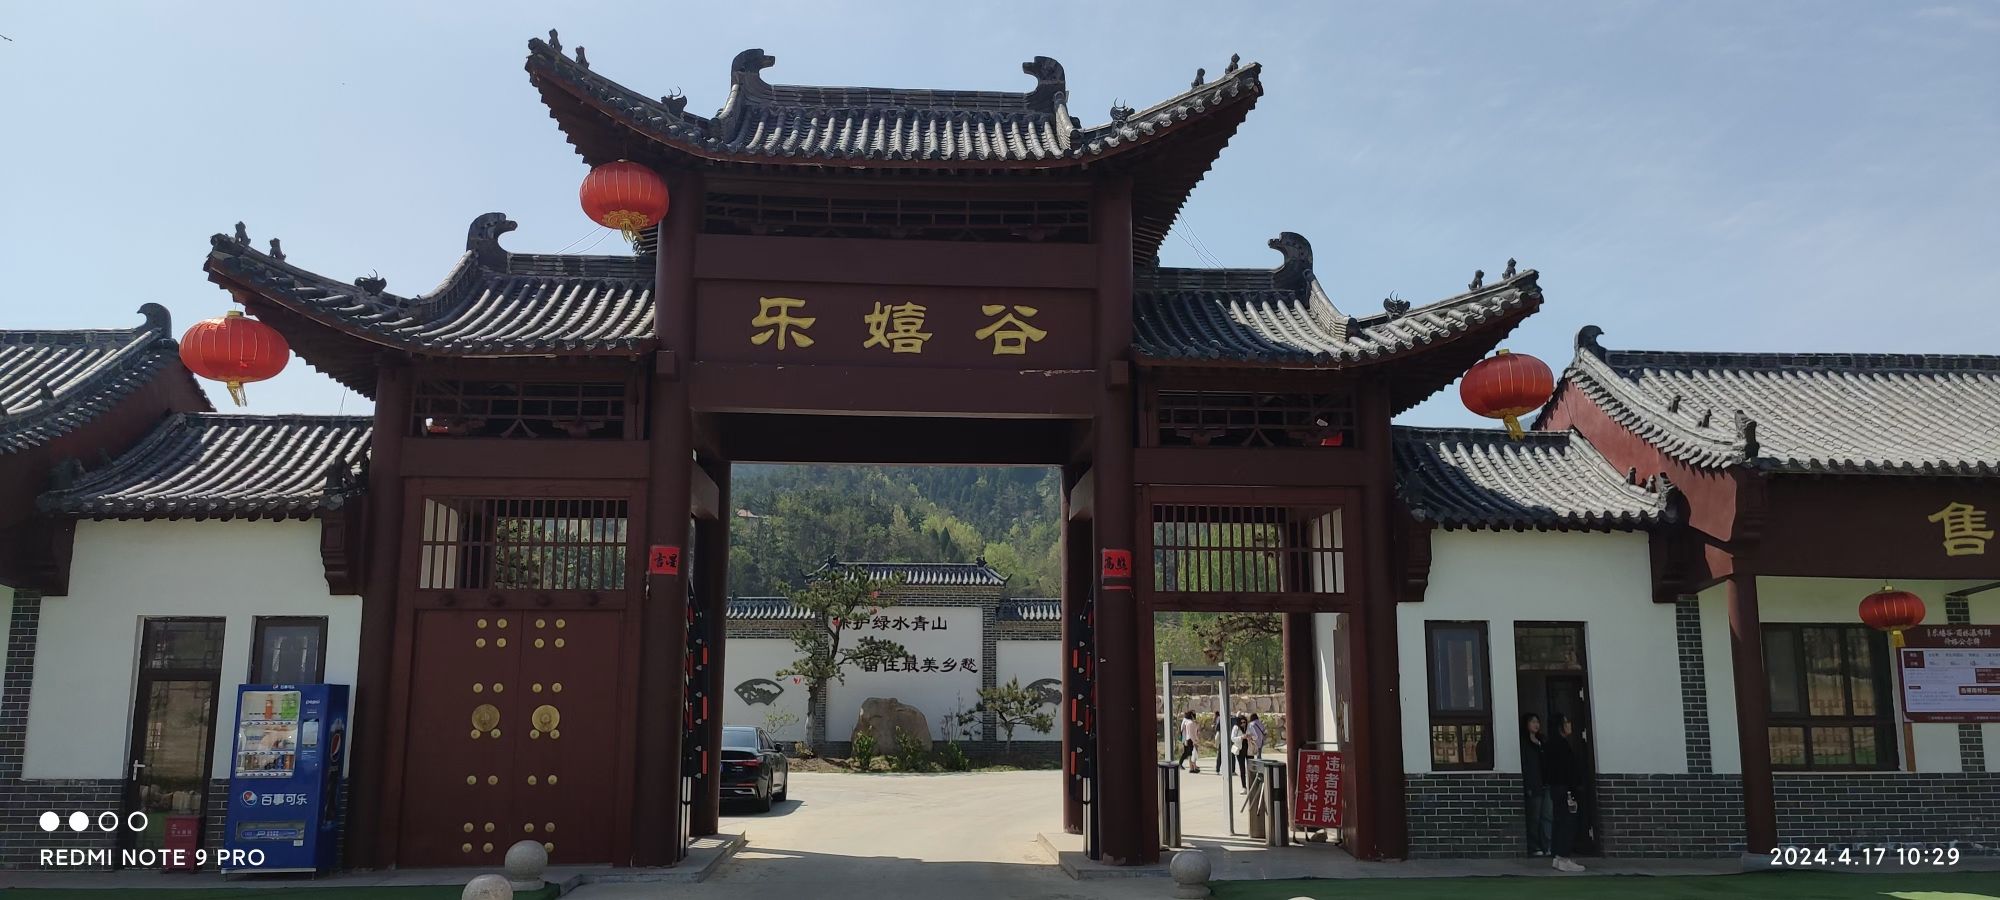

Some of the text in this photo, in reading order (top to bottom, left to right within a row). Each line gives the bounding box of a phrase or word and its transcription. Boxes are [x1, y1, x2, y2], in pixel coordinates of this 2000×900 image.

[750, 296, 1048, 356] 乐嬉谷
[1927, 501, 1995, 557] 售
[261, 793, 308, 806] 百事可乐
[1302, 754, 1321, 822] 严禁带火种上山
[1321, 756, 1341, 823] 违者罚款
